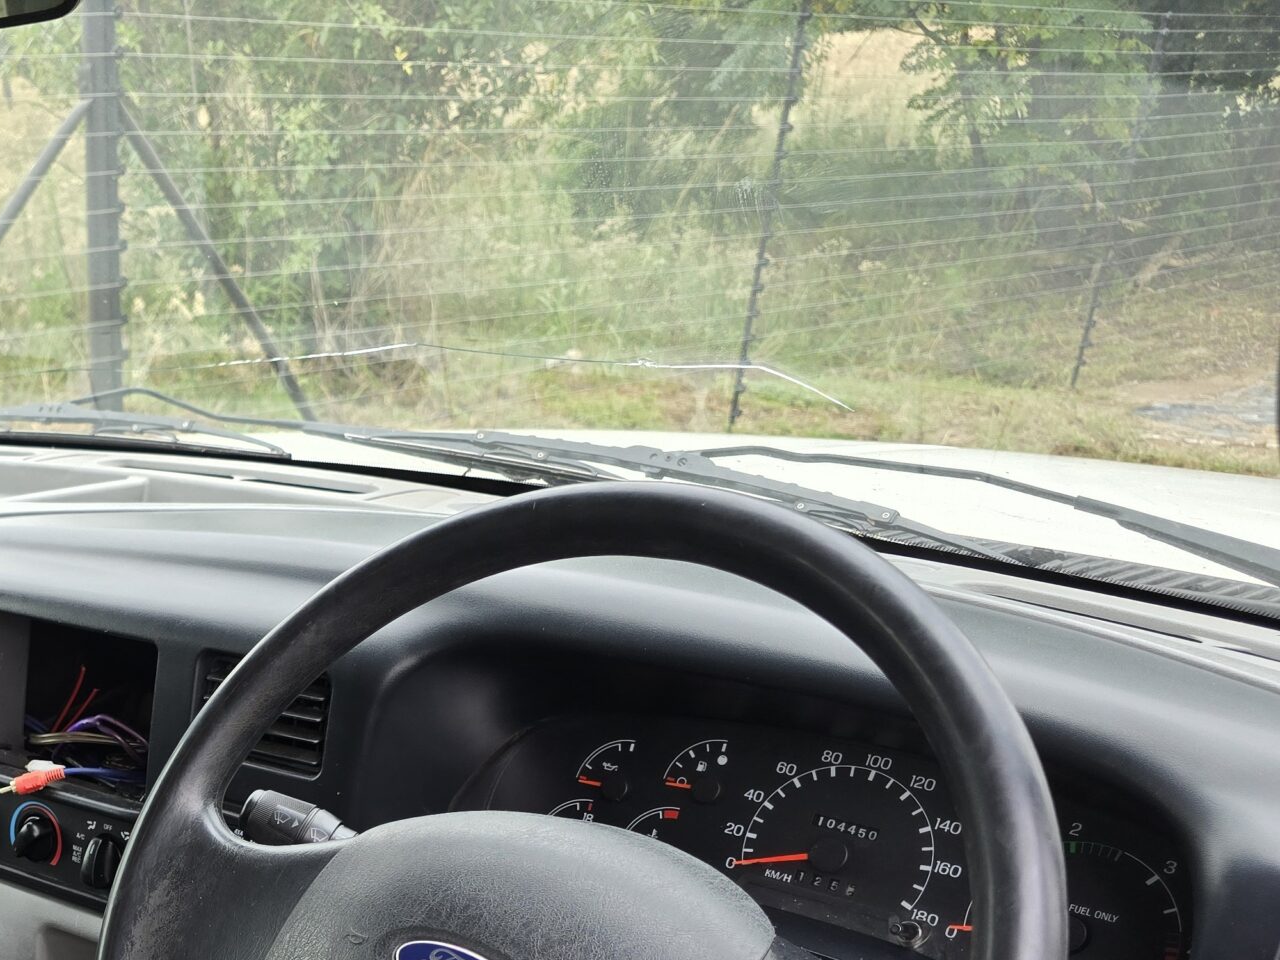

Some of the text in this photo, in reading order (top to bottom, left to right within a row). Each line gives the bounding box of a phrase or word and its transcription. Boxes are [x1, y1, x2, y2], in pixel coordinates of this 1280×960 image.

[821, 750, 843, 765] 80
[865, 753, 892, 771] 100
[776, 762, 798, 776] 60
[910, 775, 937, 791] 120
[744, 789, 765, 803] 40
[724, 823, 744, 837] 20
[818, 816, 878, 841] 104450
[934, 817, 962, 835] 140
[1069, 823, 1082, 837] 2
[725, 856, 737, 870] 0
[934, 861, 962, 878] 160
[1163, 860, 1178, 875] 3
[764, 868, 792, 883] KM/H
[911, 908, 939, 927] 180
[1068, 903, 1119, 924] FUEL ONLY
